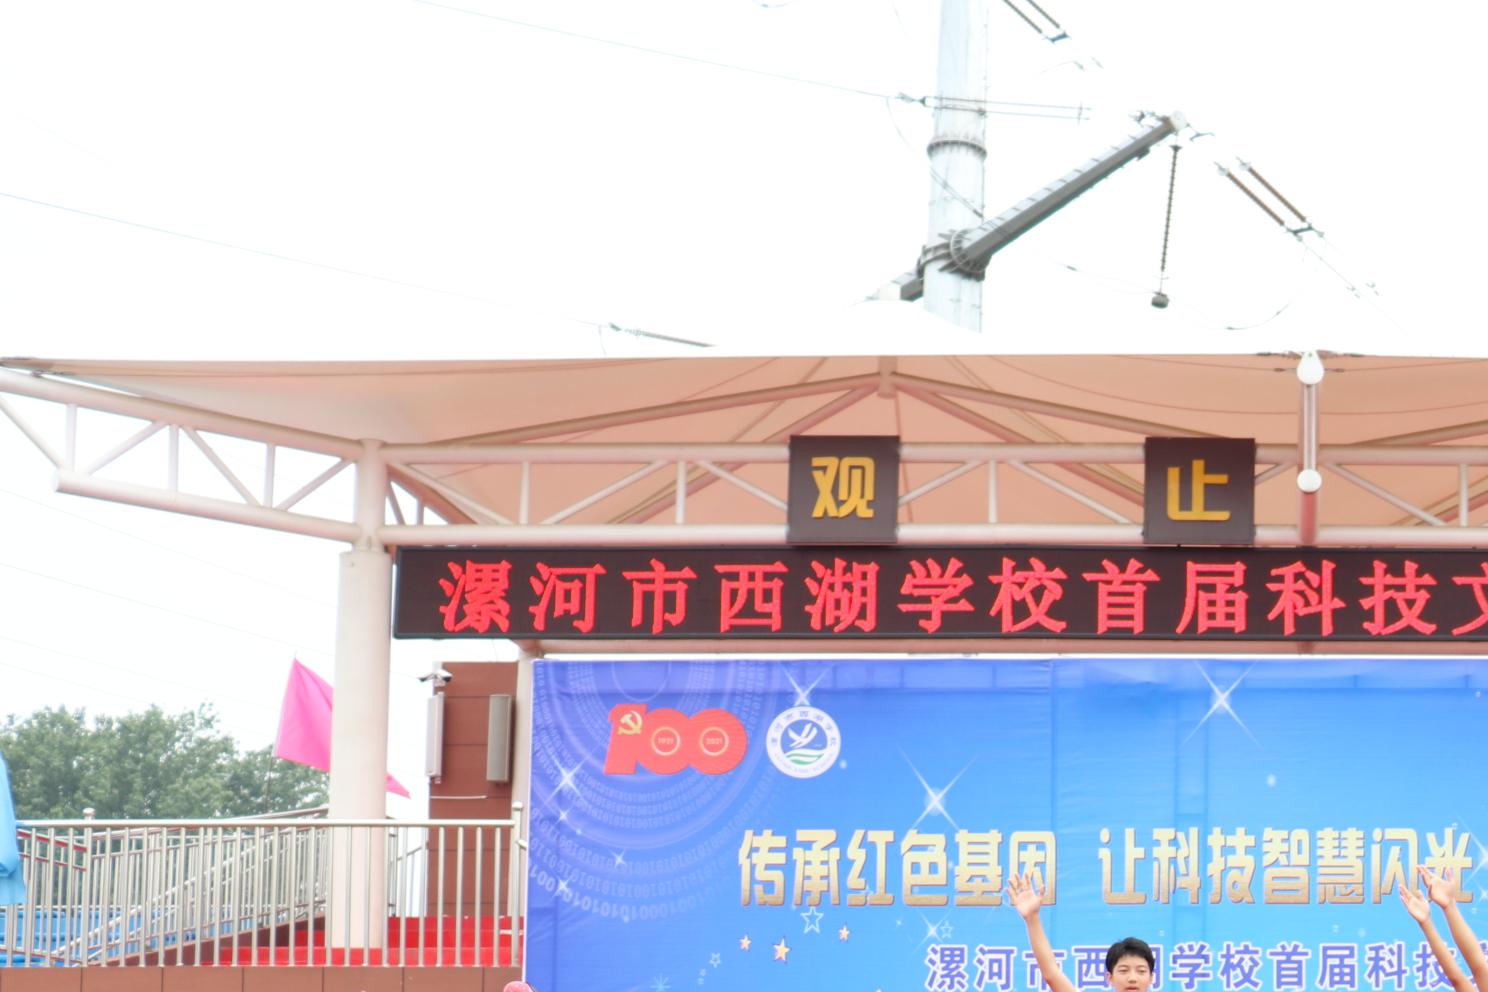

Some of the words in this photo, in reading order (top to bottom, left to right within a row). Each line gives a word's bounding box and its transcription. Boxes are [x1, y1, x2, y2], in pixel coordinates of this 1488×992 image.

[811, 456, 876, 519] 观
[1166, 459, 1232, 522] 止
[738, 827, 1057, 906] 传承红色基因
[1098, 827, 1473, 906] 让科技智慧闪光
